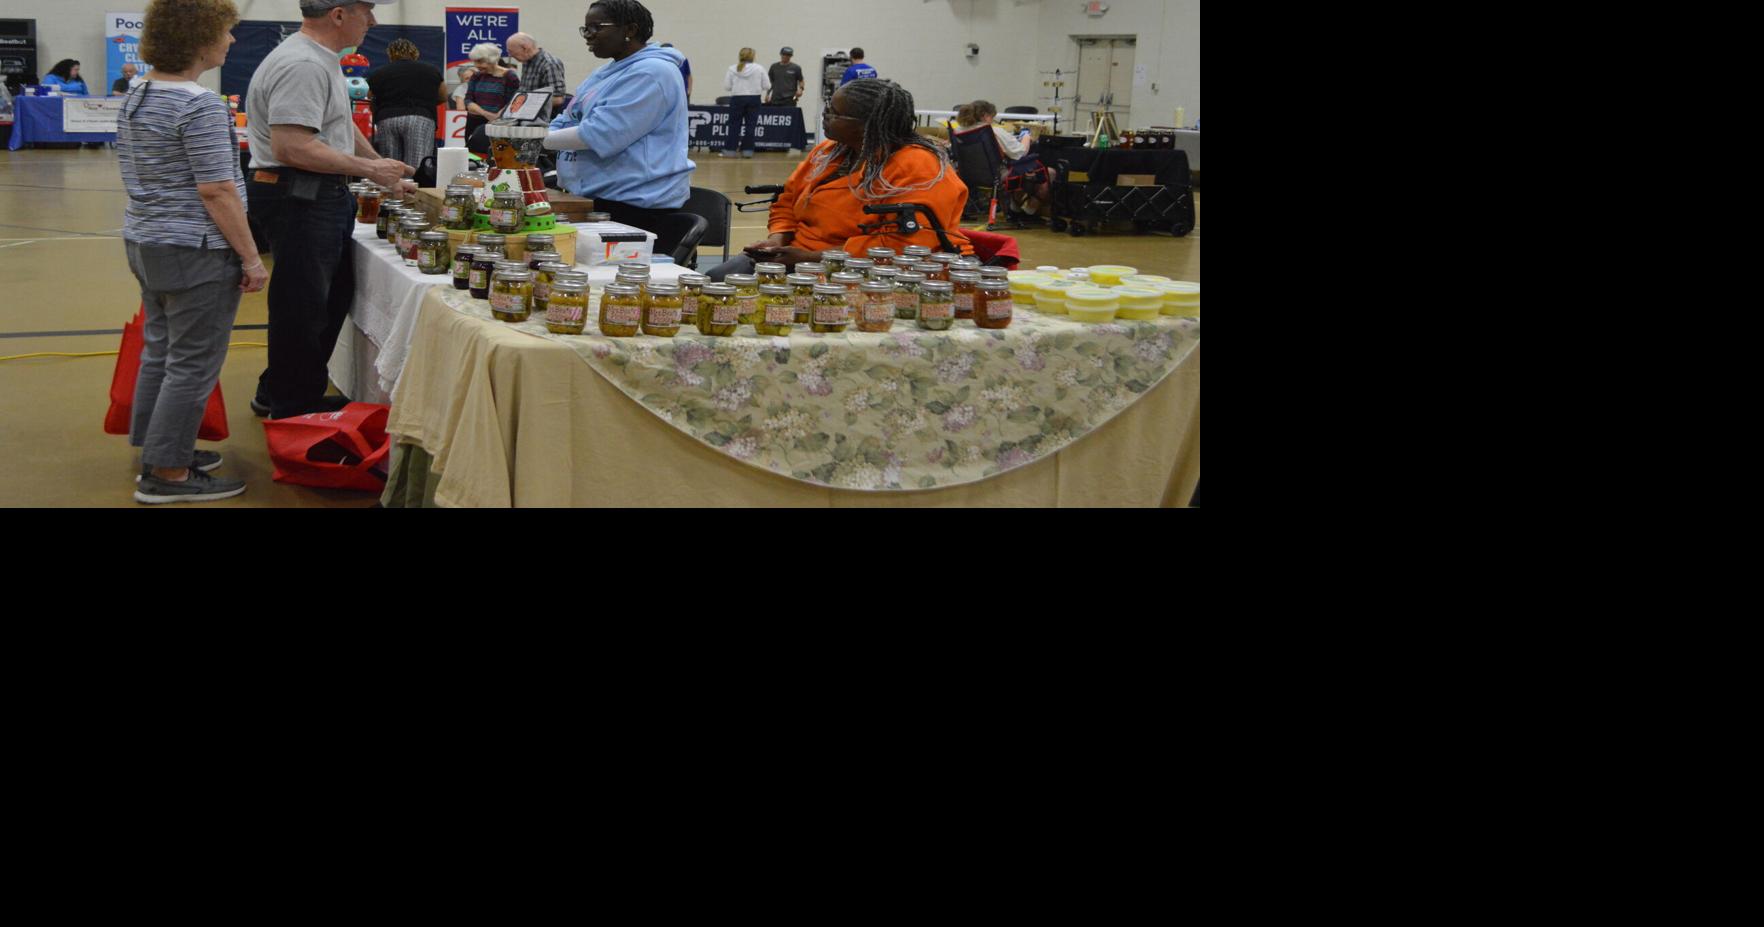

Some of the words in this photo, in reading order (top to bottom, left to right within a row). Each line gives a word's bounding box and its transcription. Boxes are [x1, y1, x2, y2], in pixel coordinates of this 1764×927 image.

[115, 17, 144, 29] Poo
[456, 15, 508, 27] WE'RE
[467, 29, 497, 41] ALL
[118, 43, 139, 53] CRY
[713, 113, 730, 124] PIP
